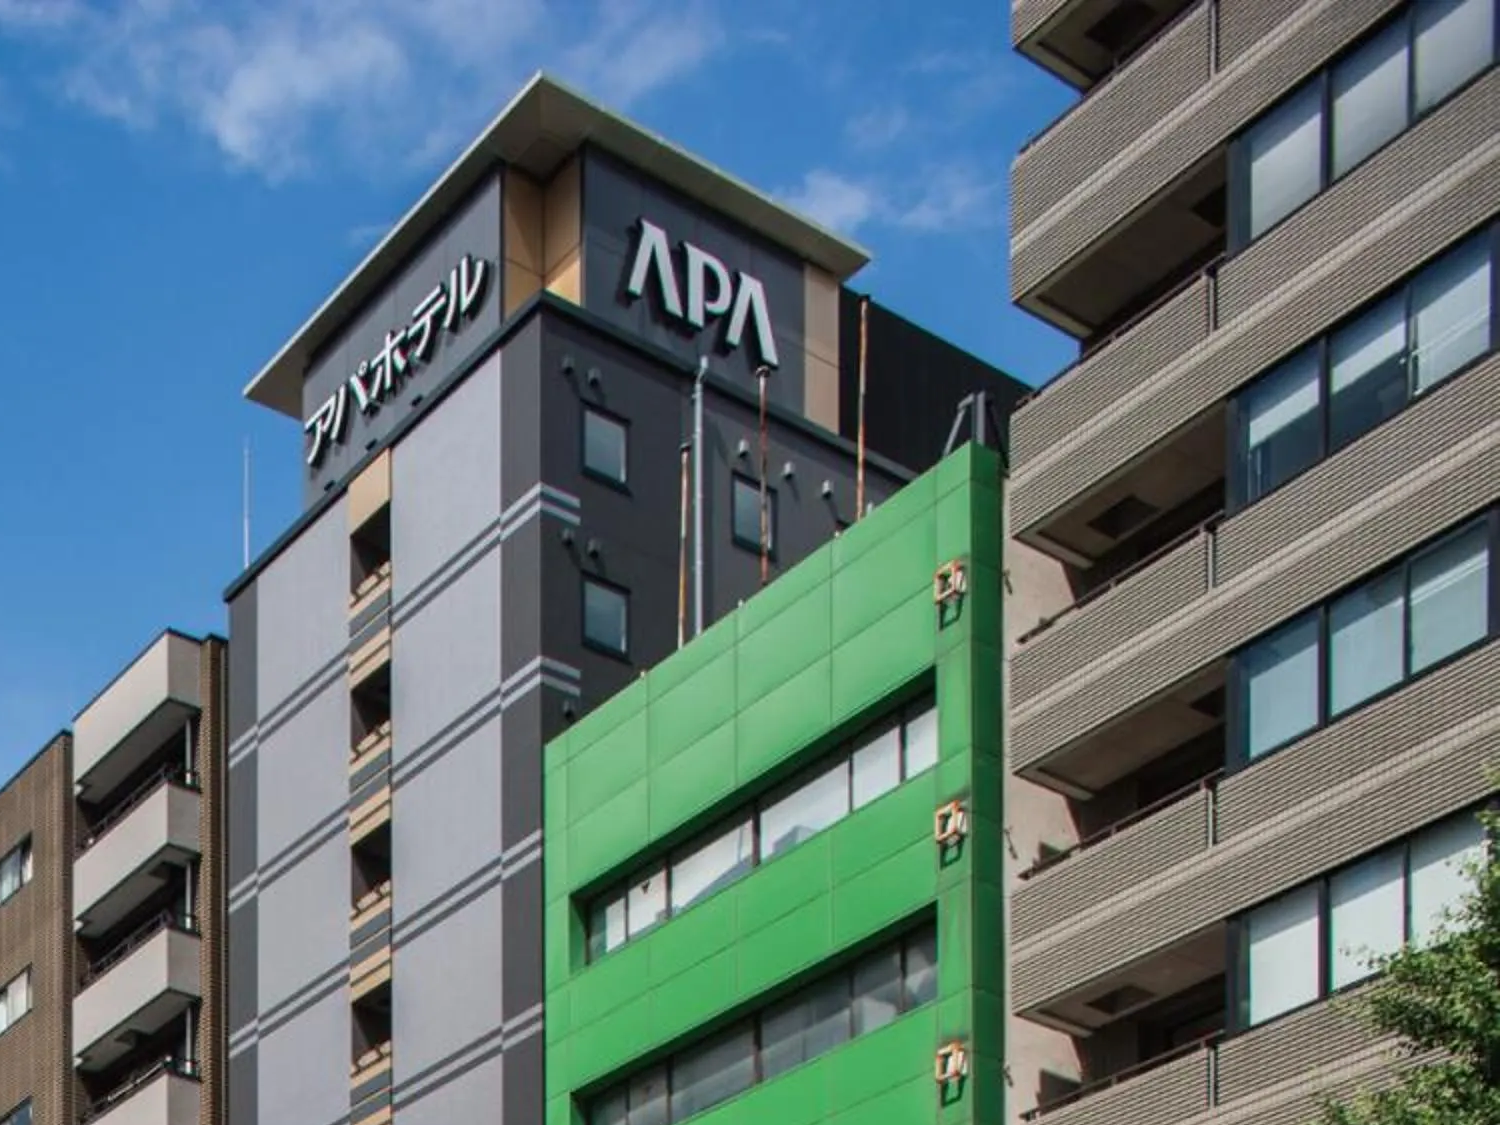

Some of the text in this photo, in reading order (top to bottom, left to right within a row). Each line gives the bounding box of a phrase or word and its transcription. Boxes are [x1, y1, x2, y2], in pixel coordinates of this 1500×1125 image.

[304, 254, 488, 466] アパホテル
[628, 218, 779, 367] APA
